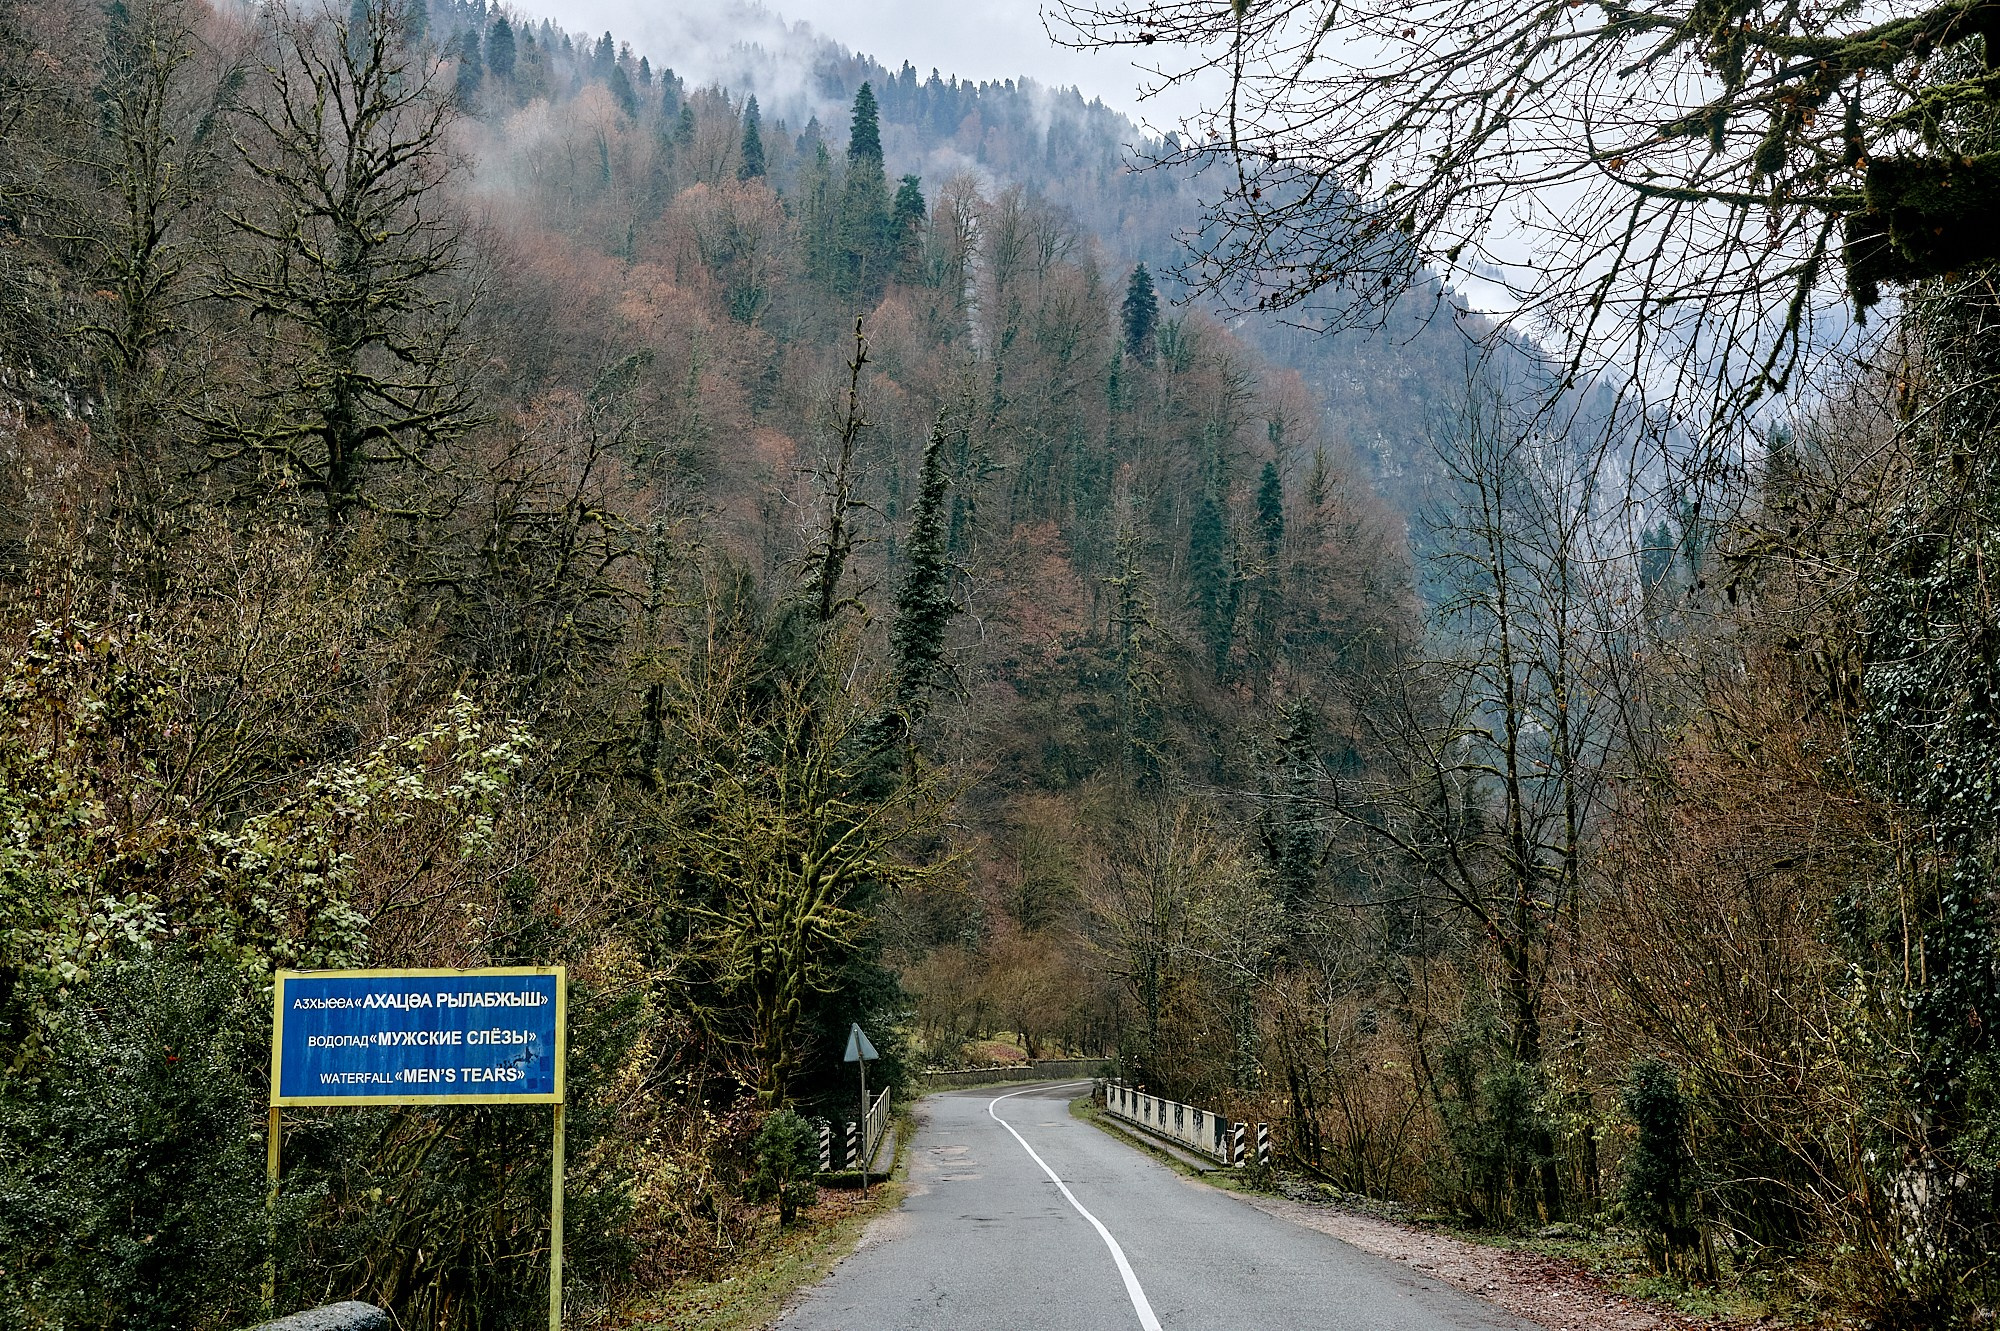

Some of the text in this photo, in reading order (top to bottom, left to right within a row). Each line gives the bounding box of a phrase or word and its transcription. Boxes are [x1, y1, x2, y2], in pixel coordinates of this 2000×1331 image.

[308, 1028, 537, 1049] ВОДОПАД «МУЖСКИЕ СЛЁЗЫ»
[320, 1072, 393, 1084] WATERFALL
[460, 1067, 525, 1082] TEARS»
